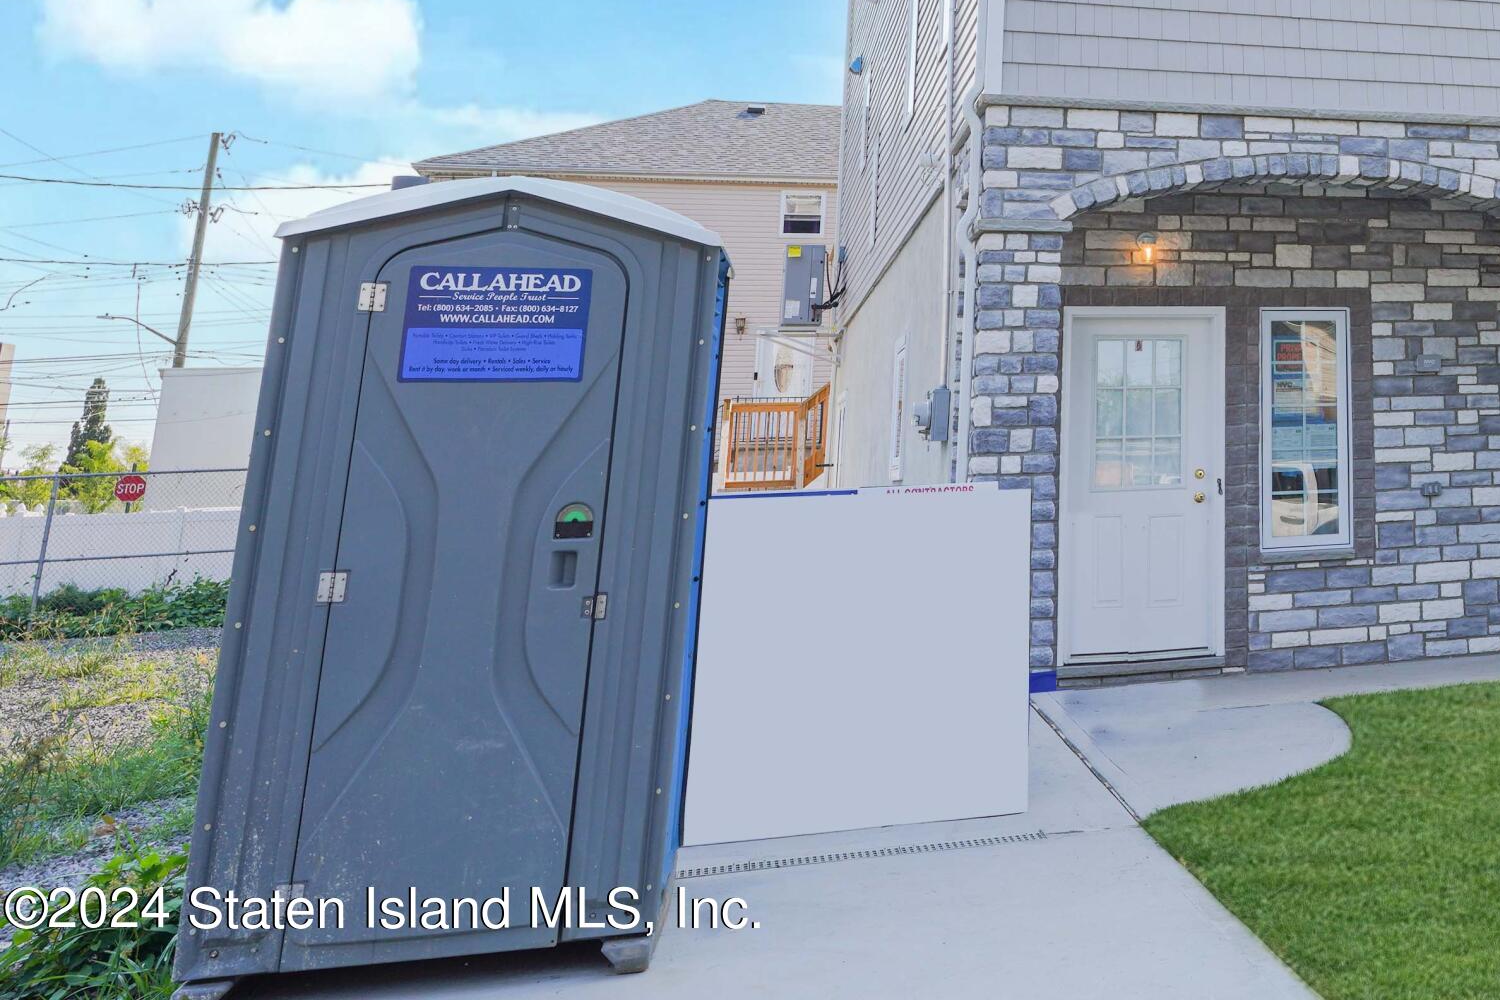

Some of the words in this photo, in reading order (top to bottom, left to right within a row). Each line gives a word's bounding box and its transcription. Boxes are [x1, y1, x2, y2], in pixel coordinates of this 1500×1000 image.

[419, 272, 581, 292] CALLAHEAD
[452, 291, 485, 301] Service
[486, 292, 518, 303] People
[520, 292, 547, 302] Trust
[417, 304, 431, 312] Tel:
[433, 304, 454, 313] (800)
[519, 305, 540, 313] (800)
[440, 314, 555, 324] WWW.CALLAHEAD.COM
[116, 483, 145, 495] STOP
